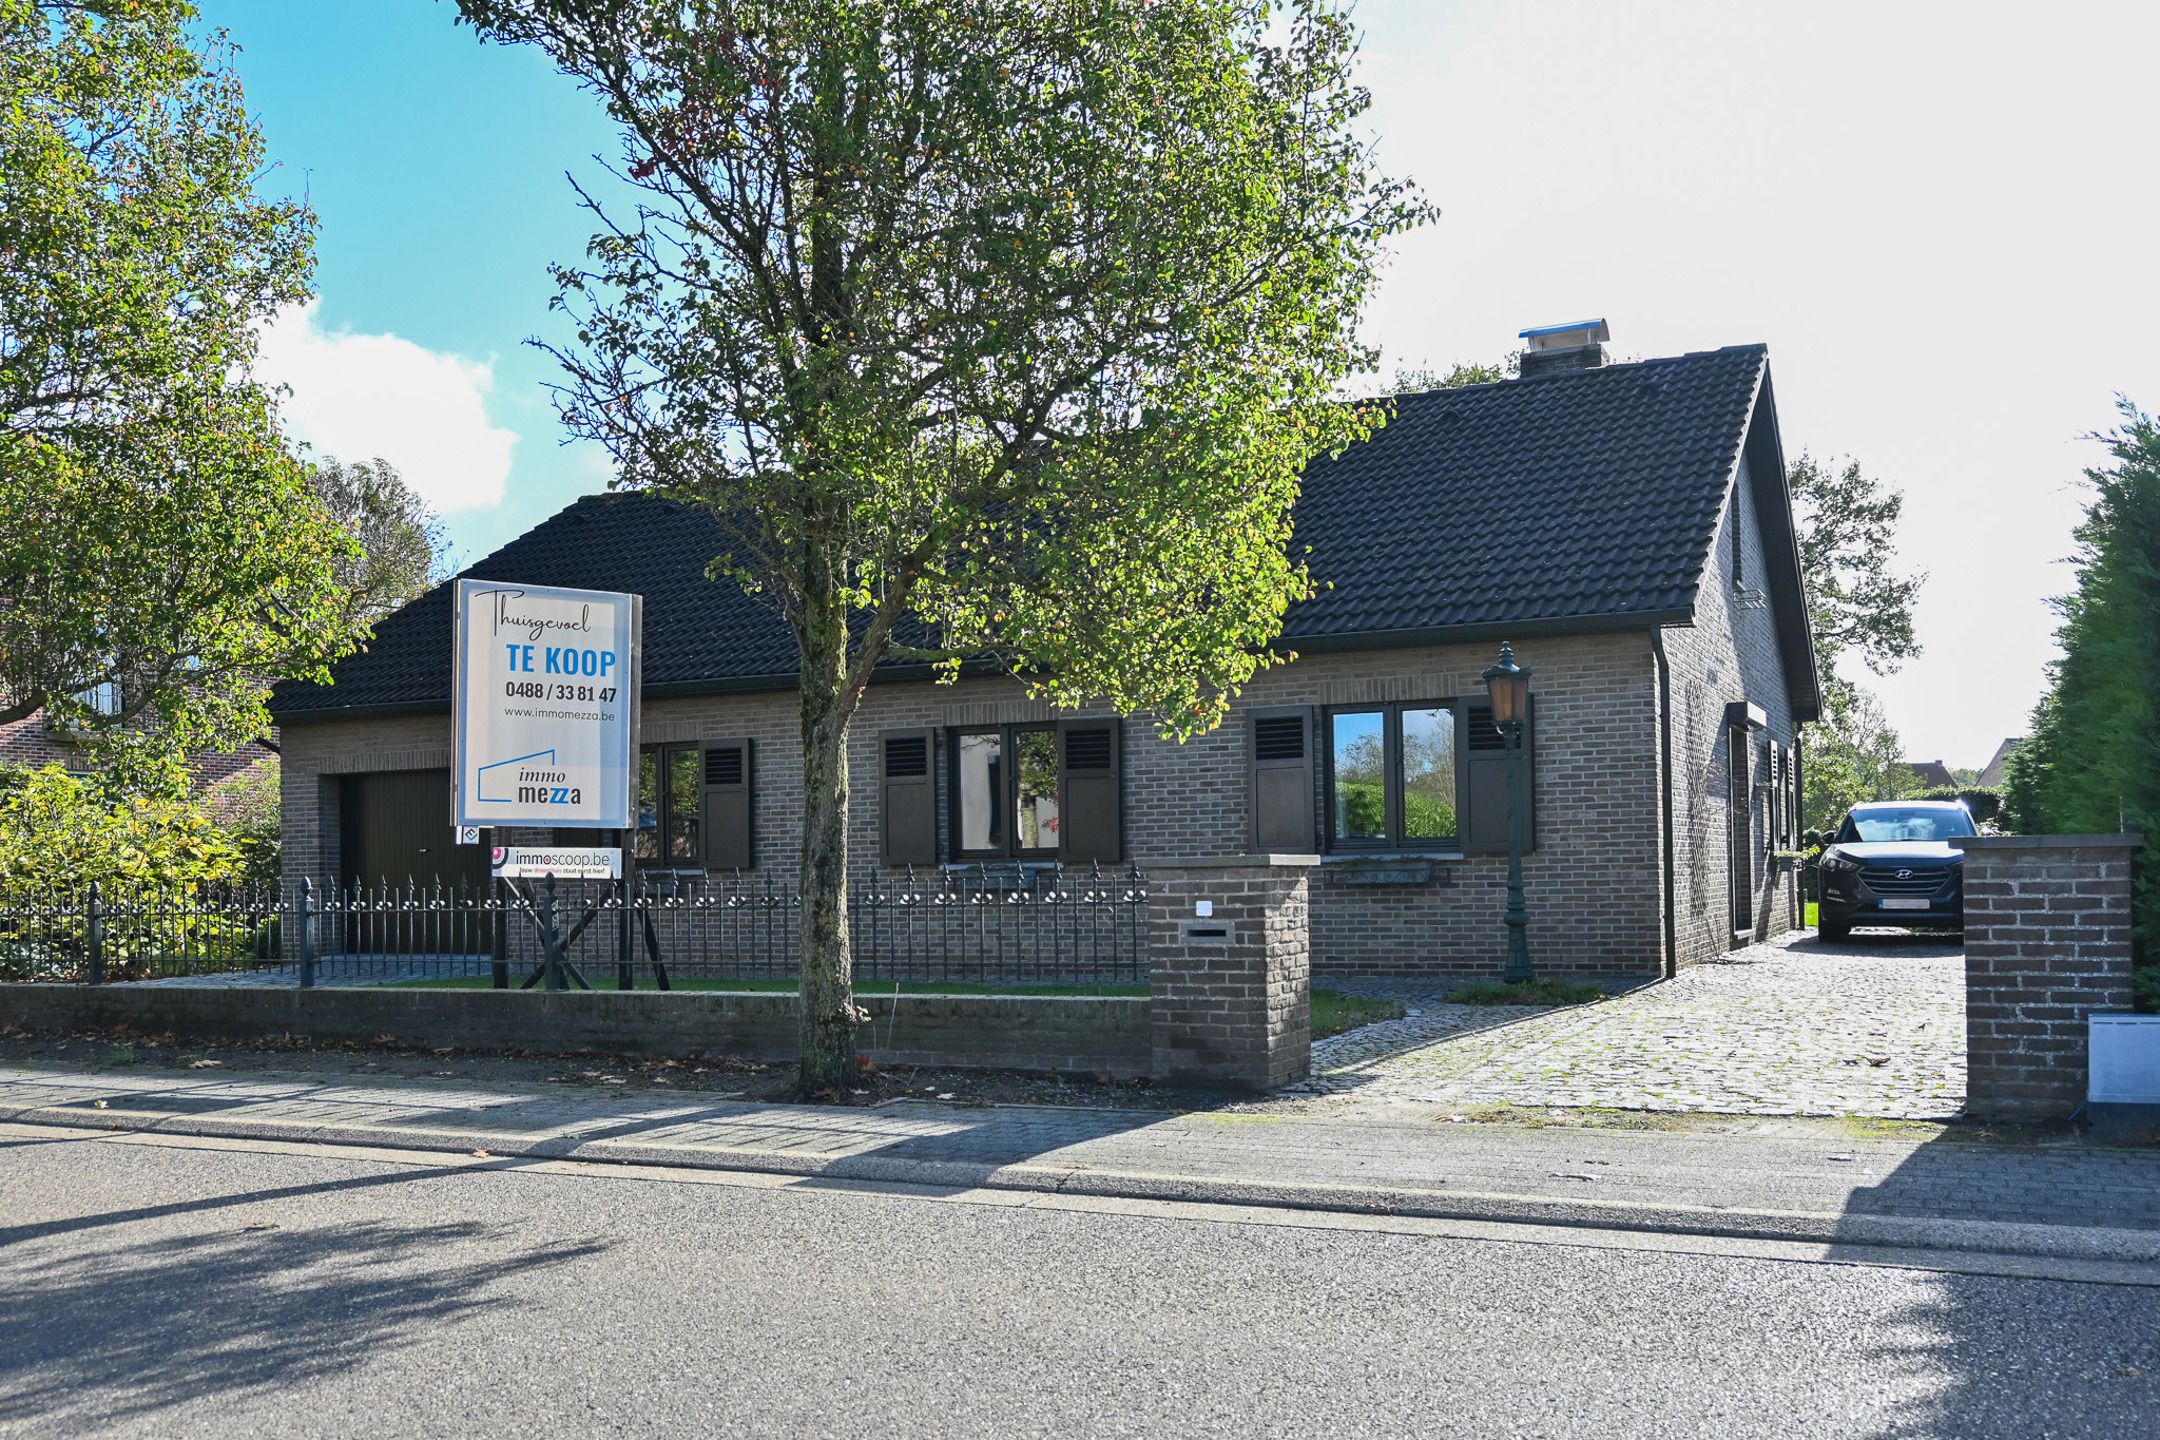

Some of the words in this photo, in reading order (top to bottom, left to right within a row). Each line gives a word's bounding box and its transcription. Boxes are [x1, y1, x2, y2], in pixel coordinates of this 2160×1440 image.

[474, 589, 592, 641] Thuisgevoel
[505, 644, 535, 673] TE
[545, 647, 616, 677] KOOP
[505, 681, 544, 699] 0488
[504, 707, 615, 721] www.immomezza.be
[518, 767, 566, 783] immo
[518, 786, 581, 805] mezza
[516, 850, 610, 868] immoscoop.be
